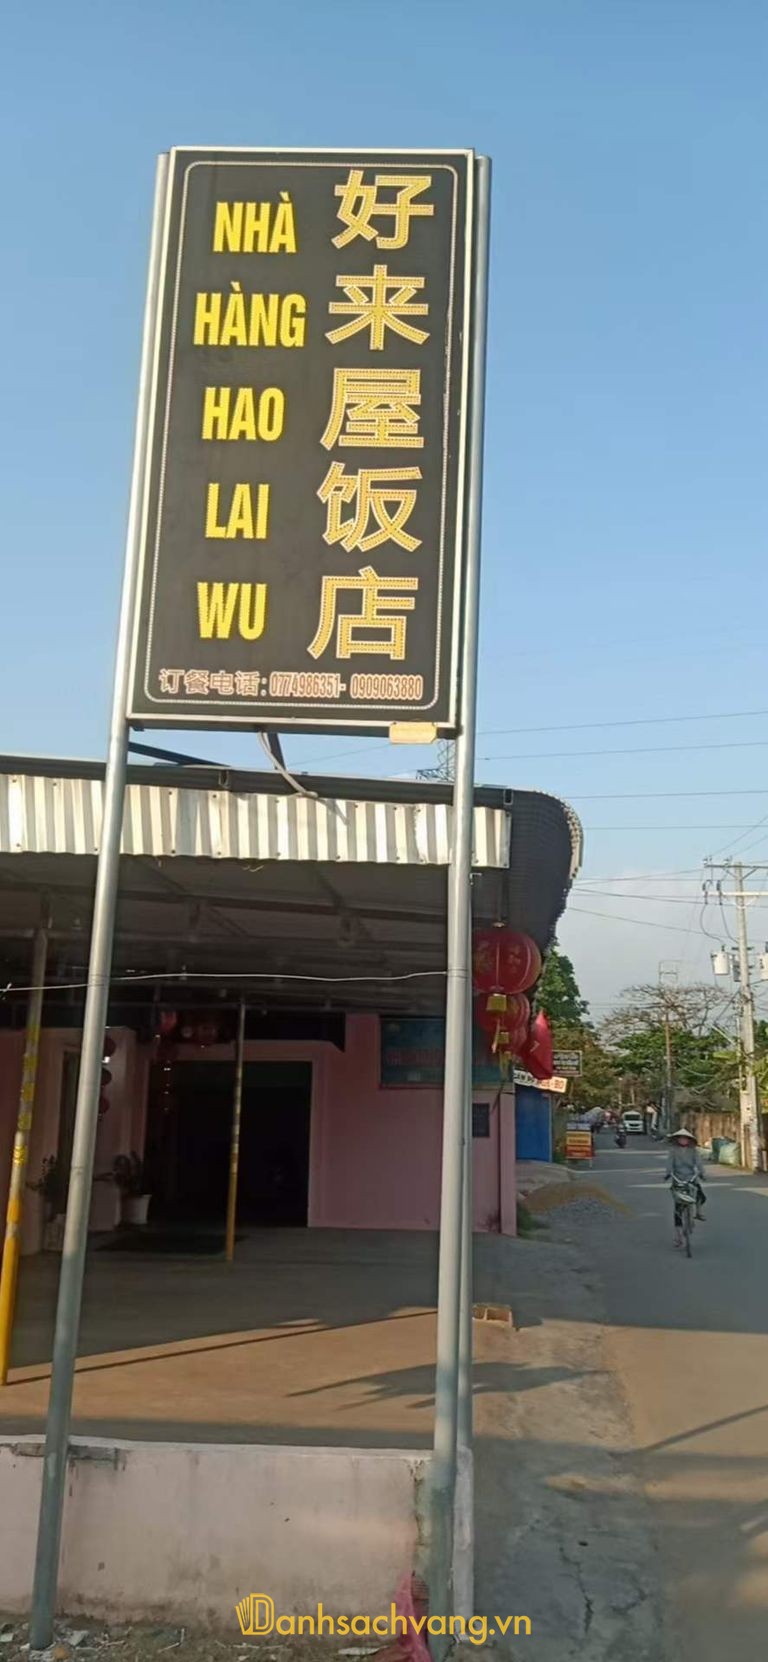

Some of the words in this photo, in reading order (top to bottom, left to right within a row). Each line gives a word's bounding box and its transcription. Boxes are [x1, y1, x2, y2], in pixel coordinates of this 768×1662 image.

[213, 191, 297, 254] NHÀ
[193, 281, 307, 348] HÀNG
[201, 387, 286, 442] HAO
[307, 170, 435, 660] 好来屋饭店
[205, 482, 270, 540] LAI
[197, 581, 267, 641] WU
[350, 673, 424, 700] 0909063880
